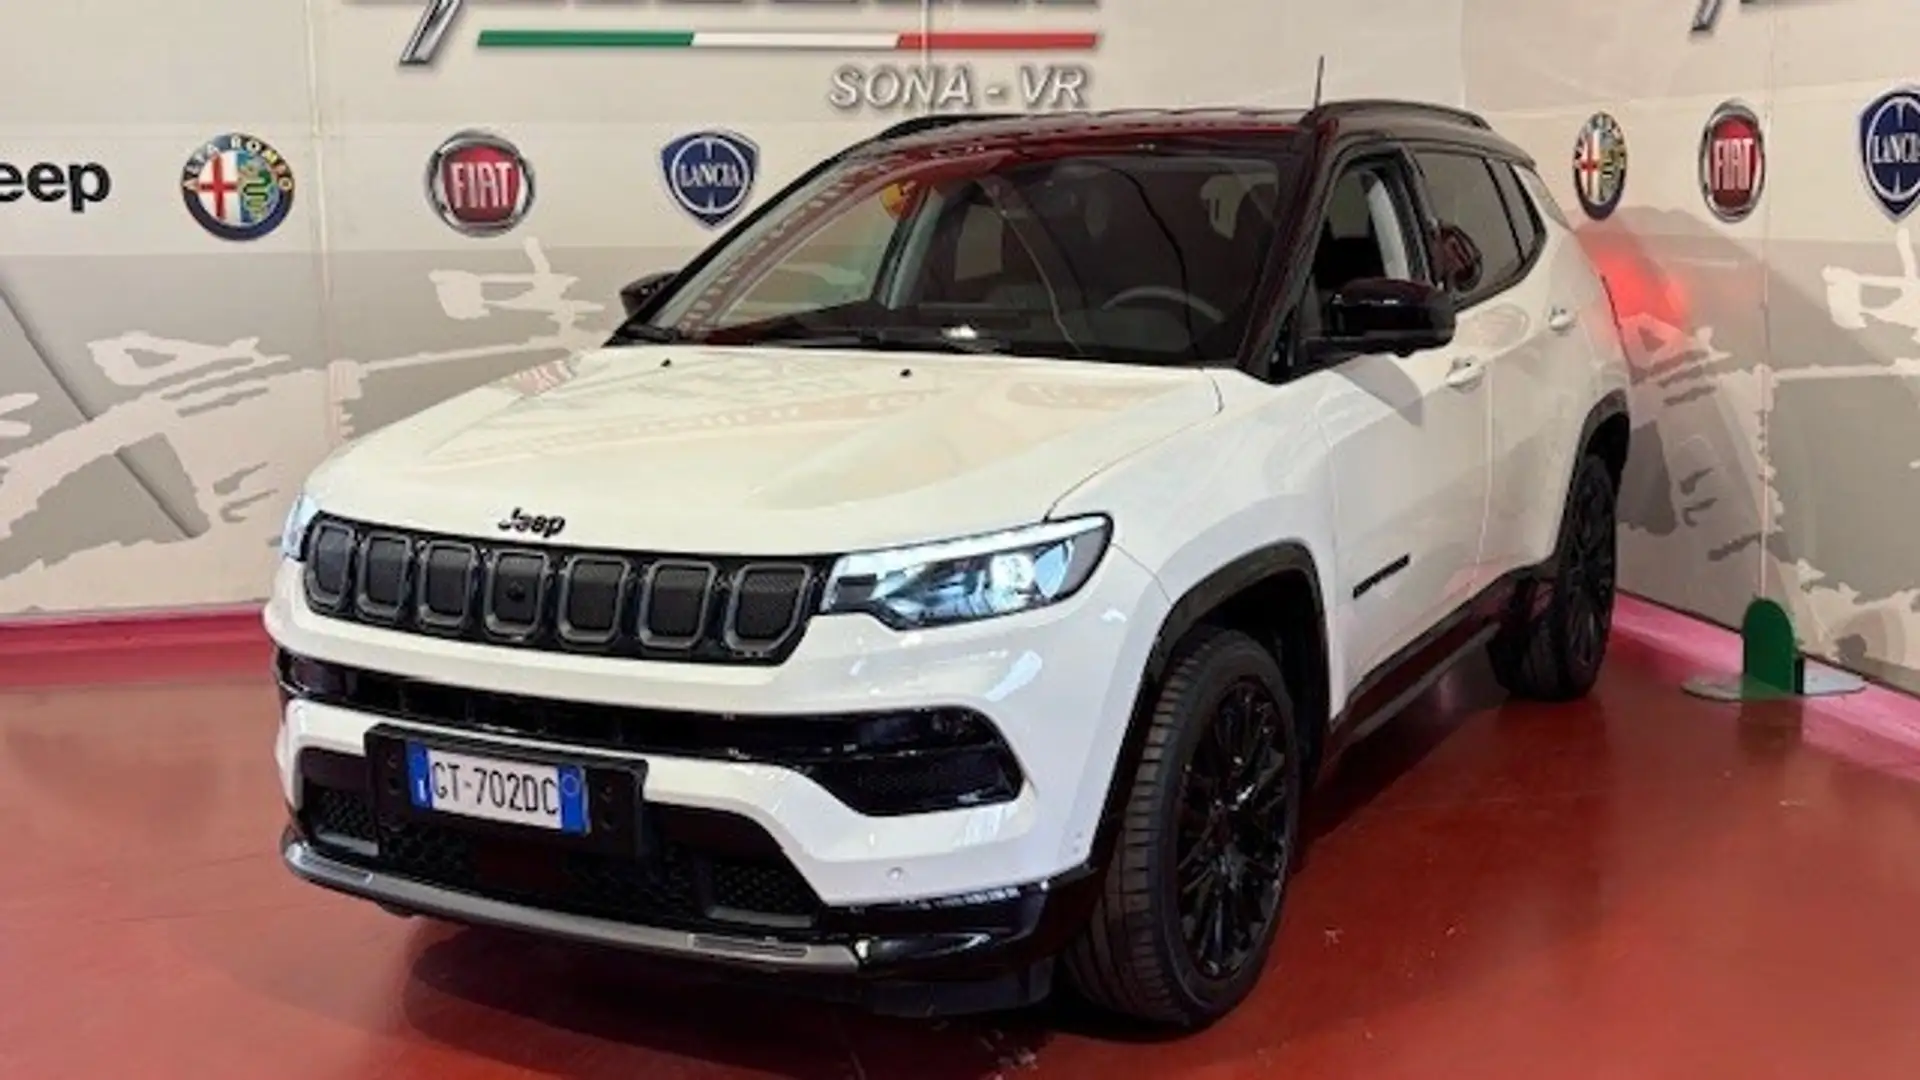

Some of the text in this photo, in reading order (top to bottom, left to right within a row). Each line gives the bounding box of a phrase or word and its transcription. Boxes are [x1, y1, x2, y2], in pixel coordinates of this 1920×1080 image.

[830, 65, 973, 107] SONA
[1020, 66, 1087, 106] VR
[451, 161, 512, 208] FIAT
[678, 162, 741, 188] LANCIA
[1713, 138, 1753, 190] FIAT
[0, 162, 112, 213] eep
[498, 507, 566, 539] Jeep
